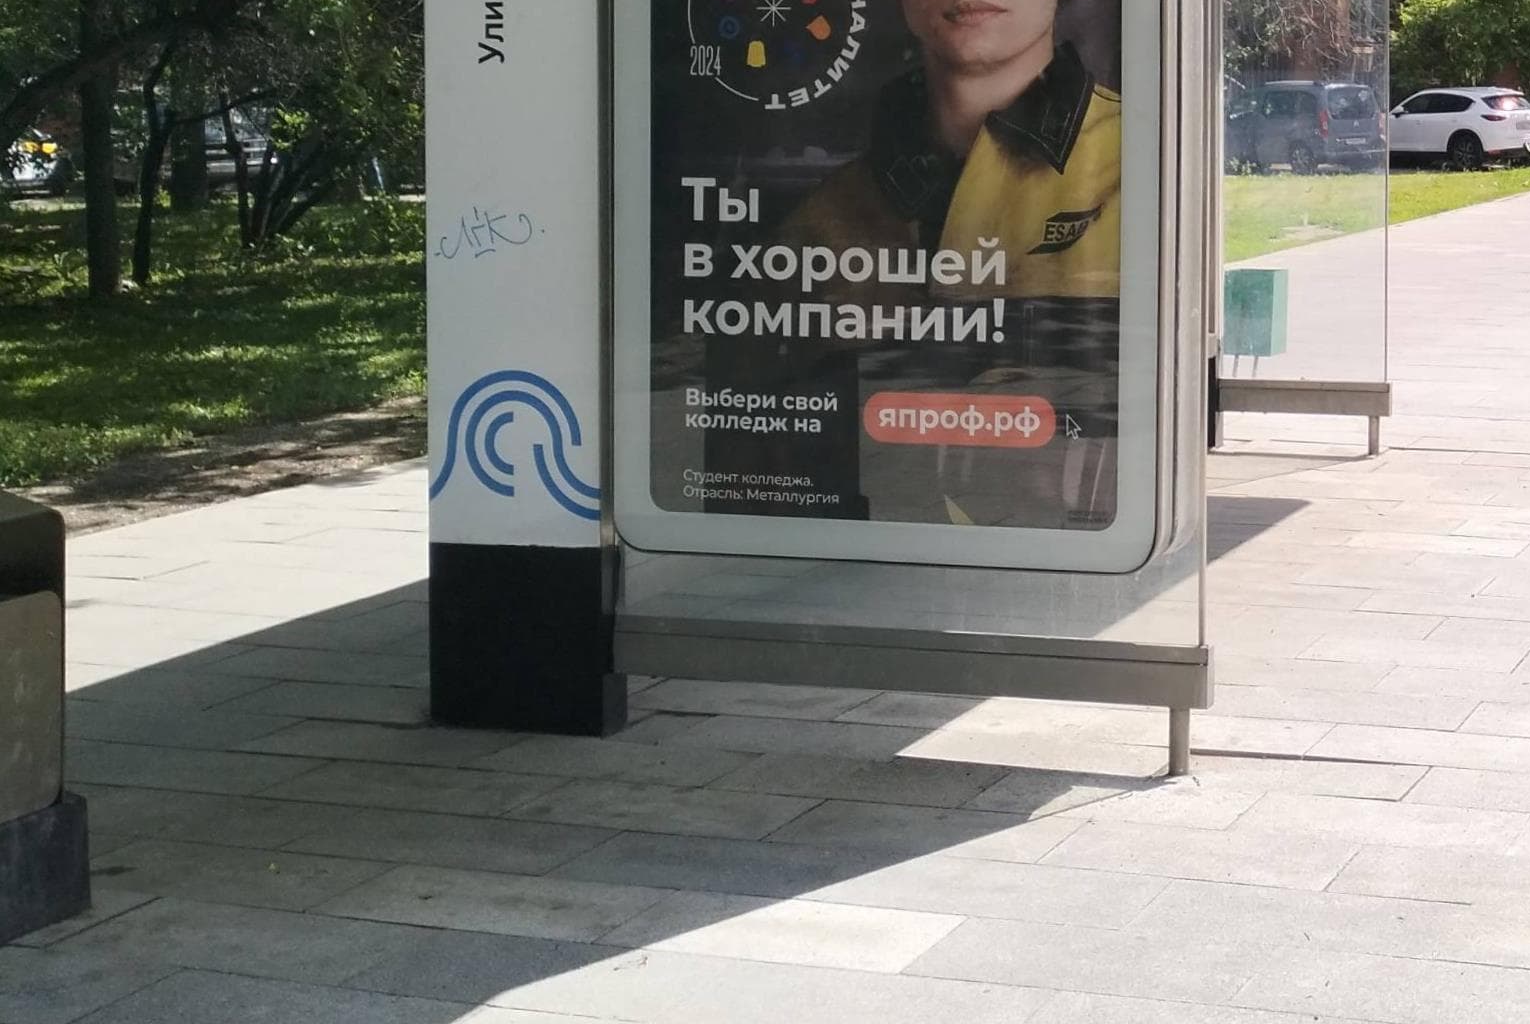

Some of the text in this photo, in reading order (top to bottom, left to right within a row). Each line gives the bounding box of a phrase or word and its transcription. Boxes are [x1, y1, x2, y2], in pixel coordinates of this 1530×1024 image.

[690, 45, 722, 77] 2024
[681, 177, 760, 223] Ты
[683, 237, 1007, 292] в хорошей
[683, 298, 1006, 344] компании!
[685, 388, 838, 413] Выбери свой
[685, 413, 822, 433] колледж на
[878, 404, 1041, 438] япроф.рф
[683, 468, 814, 488] Студент колледжа.
[683, 484, 840, 505] Отрасль: Металлургия
